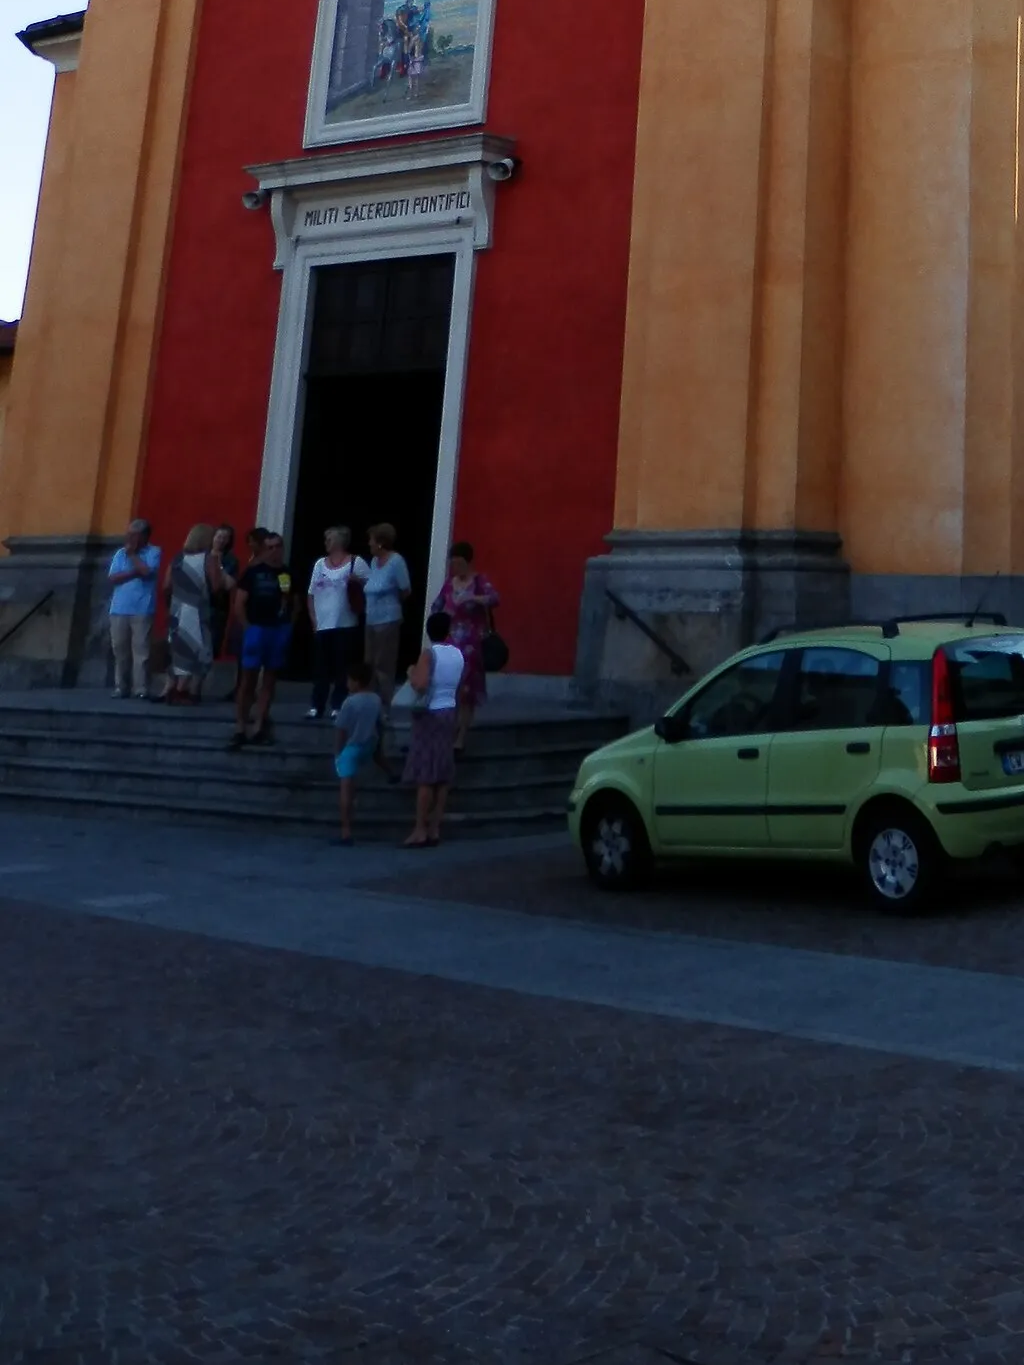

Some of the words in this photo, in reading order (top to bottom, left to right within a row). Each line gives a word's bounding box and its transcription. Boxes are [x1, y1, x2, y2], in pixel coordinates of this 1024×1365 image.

[304, 207, 339, 227] MILITI
[343, 199, 410, 223] SACERDOTI
[412, 191, 471, 214] PONTIFICI
